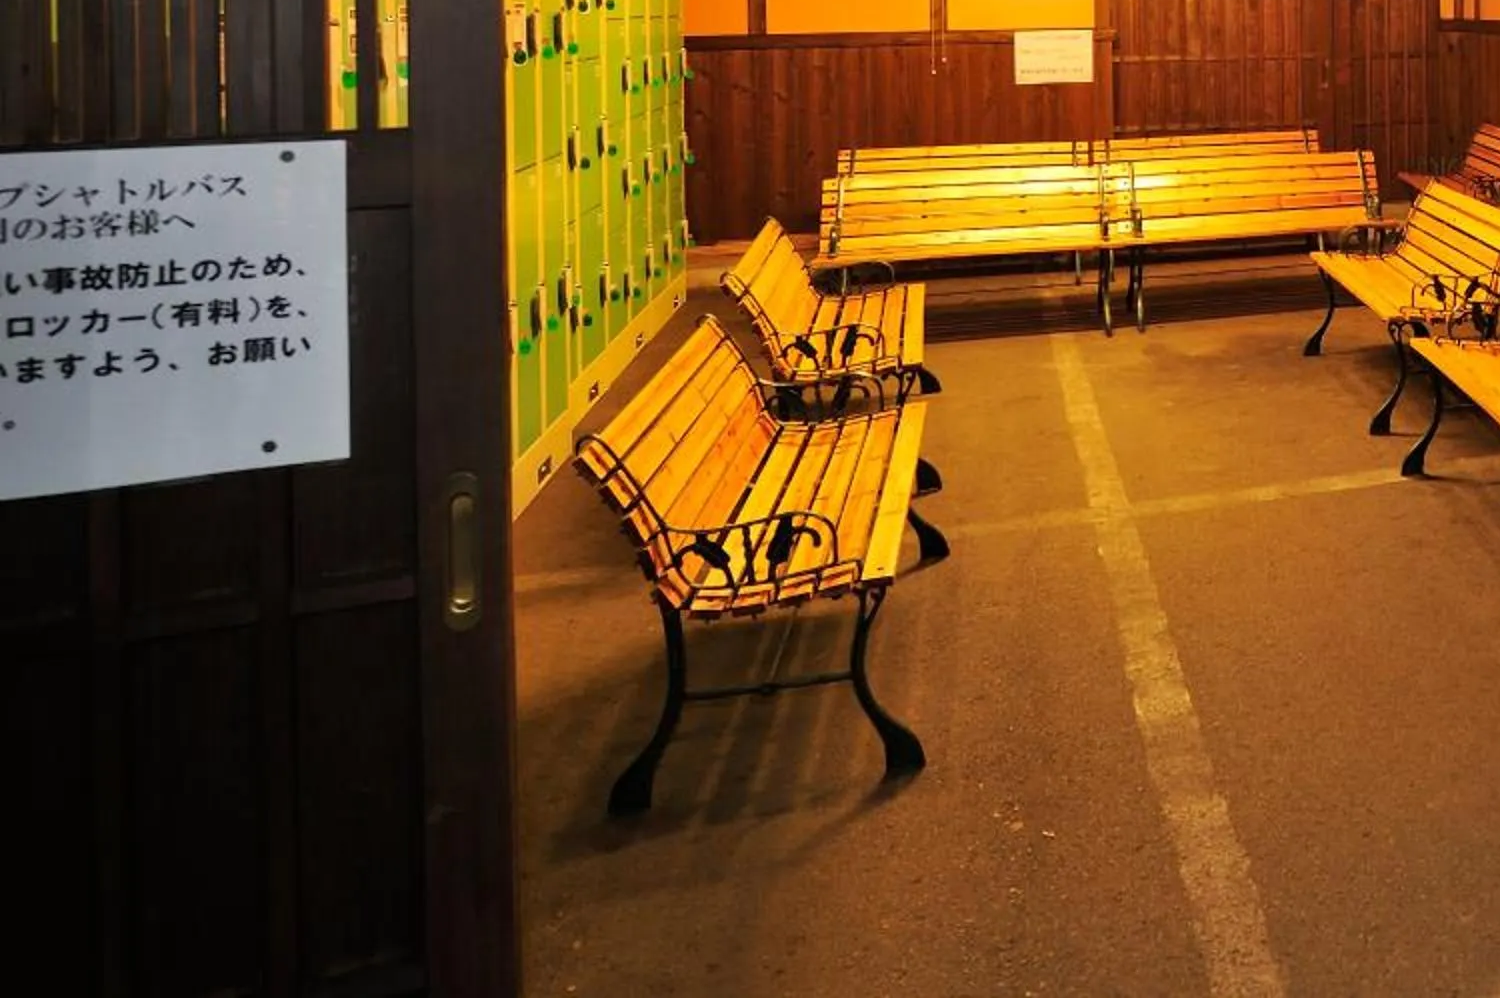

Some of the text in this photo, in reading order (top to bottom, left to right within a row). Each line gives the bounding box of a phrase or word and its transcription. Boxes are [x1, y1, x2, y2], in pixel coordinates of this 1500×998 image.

[0, 208, 196, 245] のお客様へ
